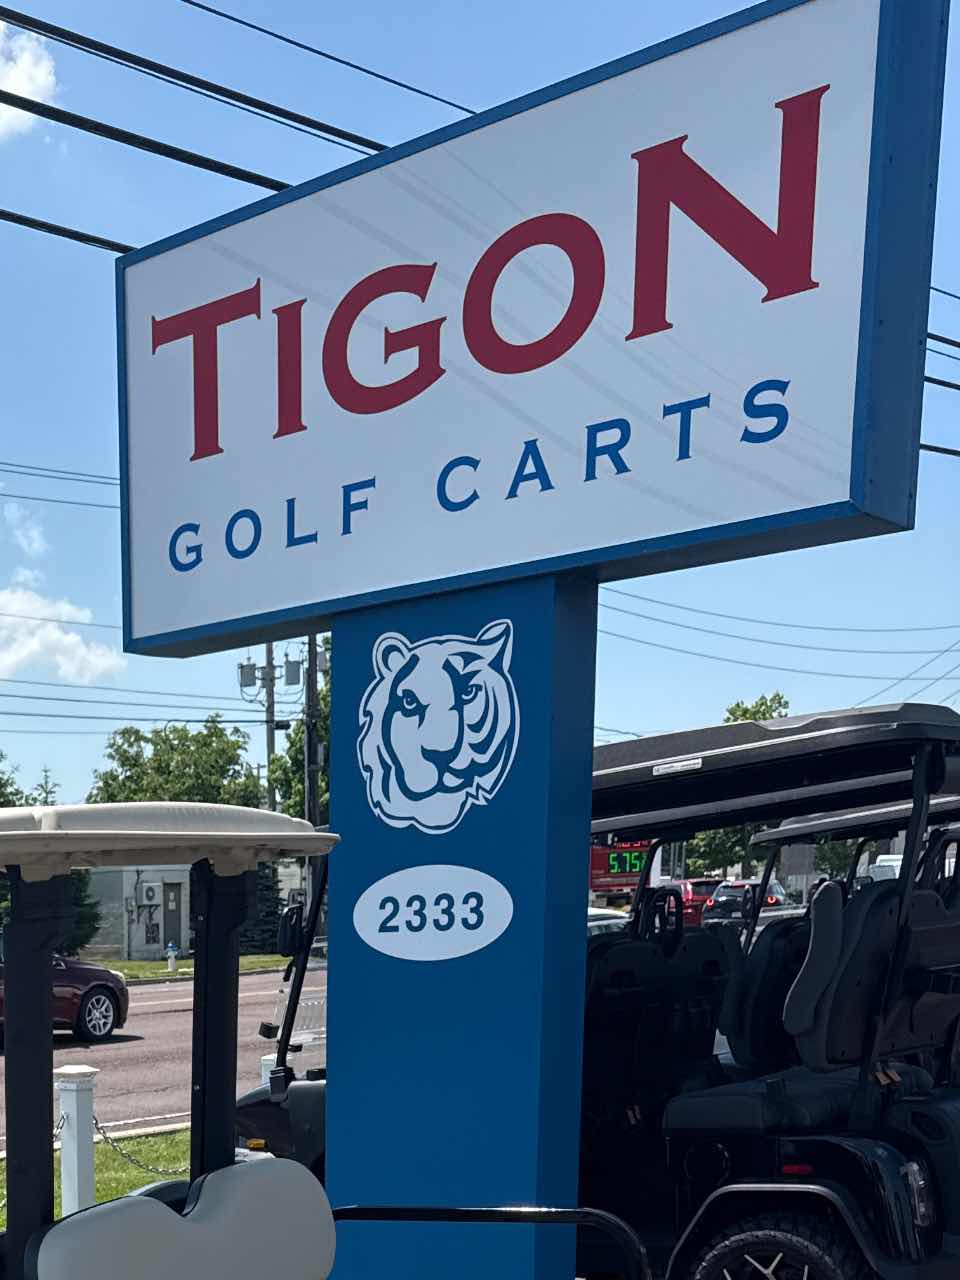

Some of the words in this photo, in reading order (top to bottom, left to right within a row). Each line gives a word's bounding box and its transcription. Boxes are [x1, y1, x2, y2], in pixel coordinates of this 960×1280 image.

[151, 84, 831, 462] TIGON
[169, 476, 376, 573] GOLF
[436, 378, 791, 512] CARTS
[377, 891, 485, 933] 2333
